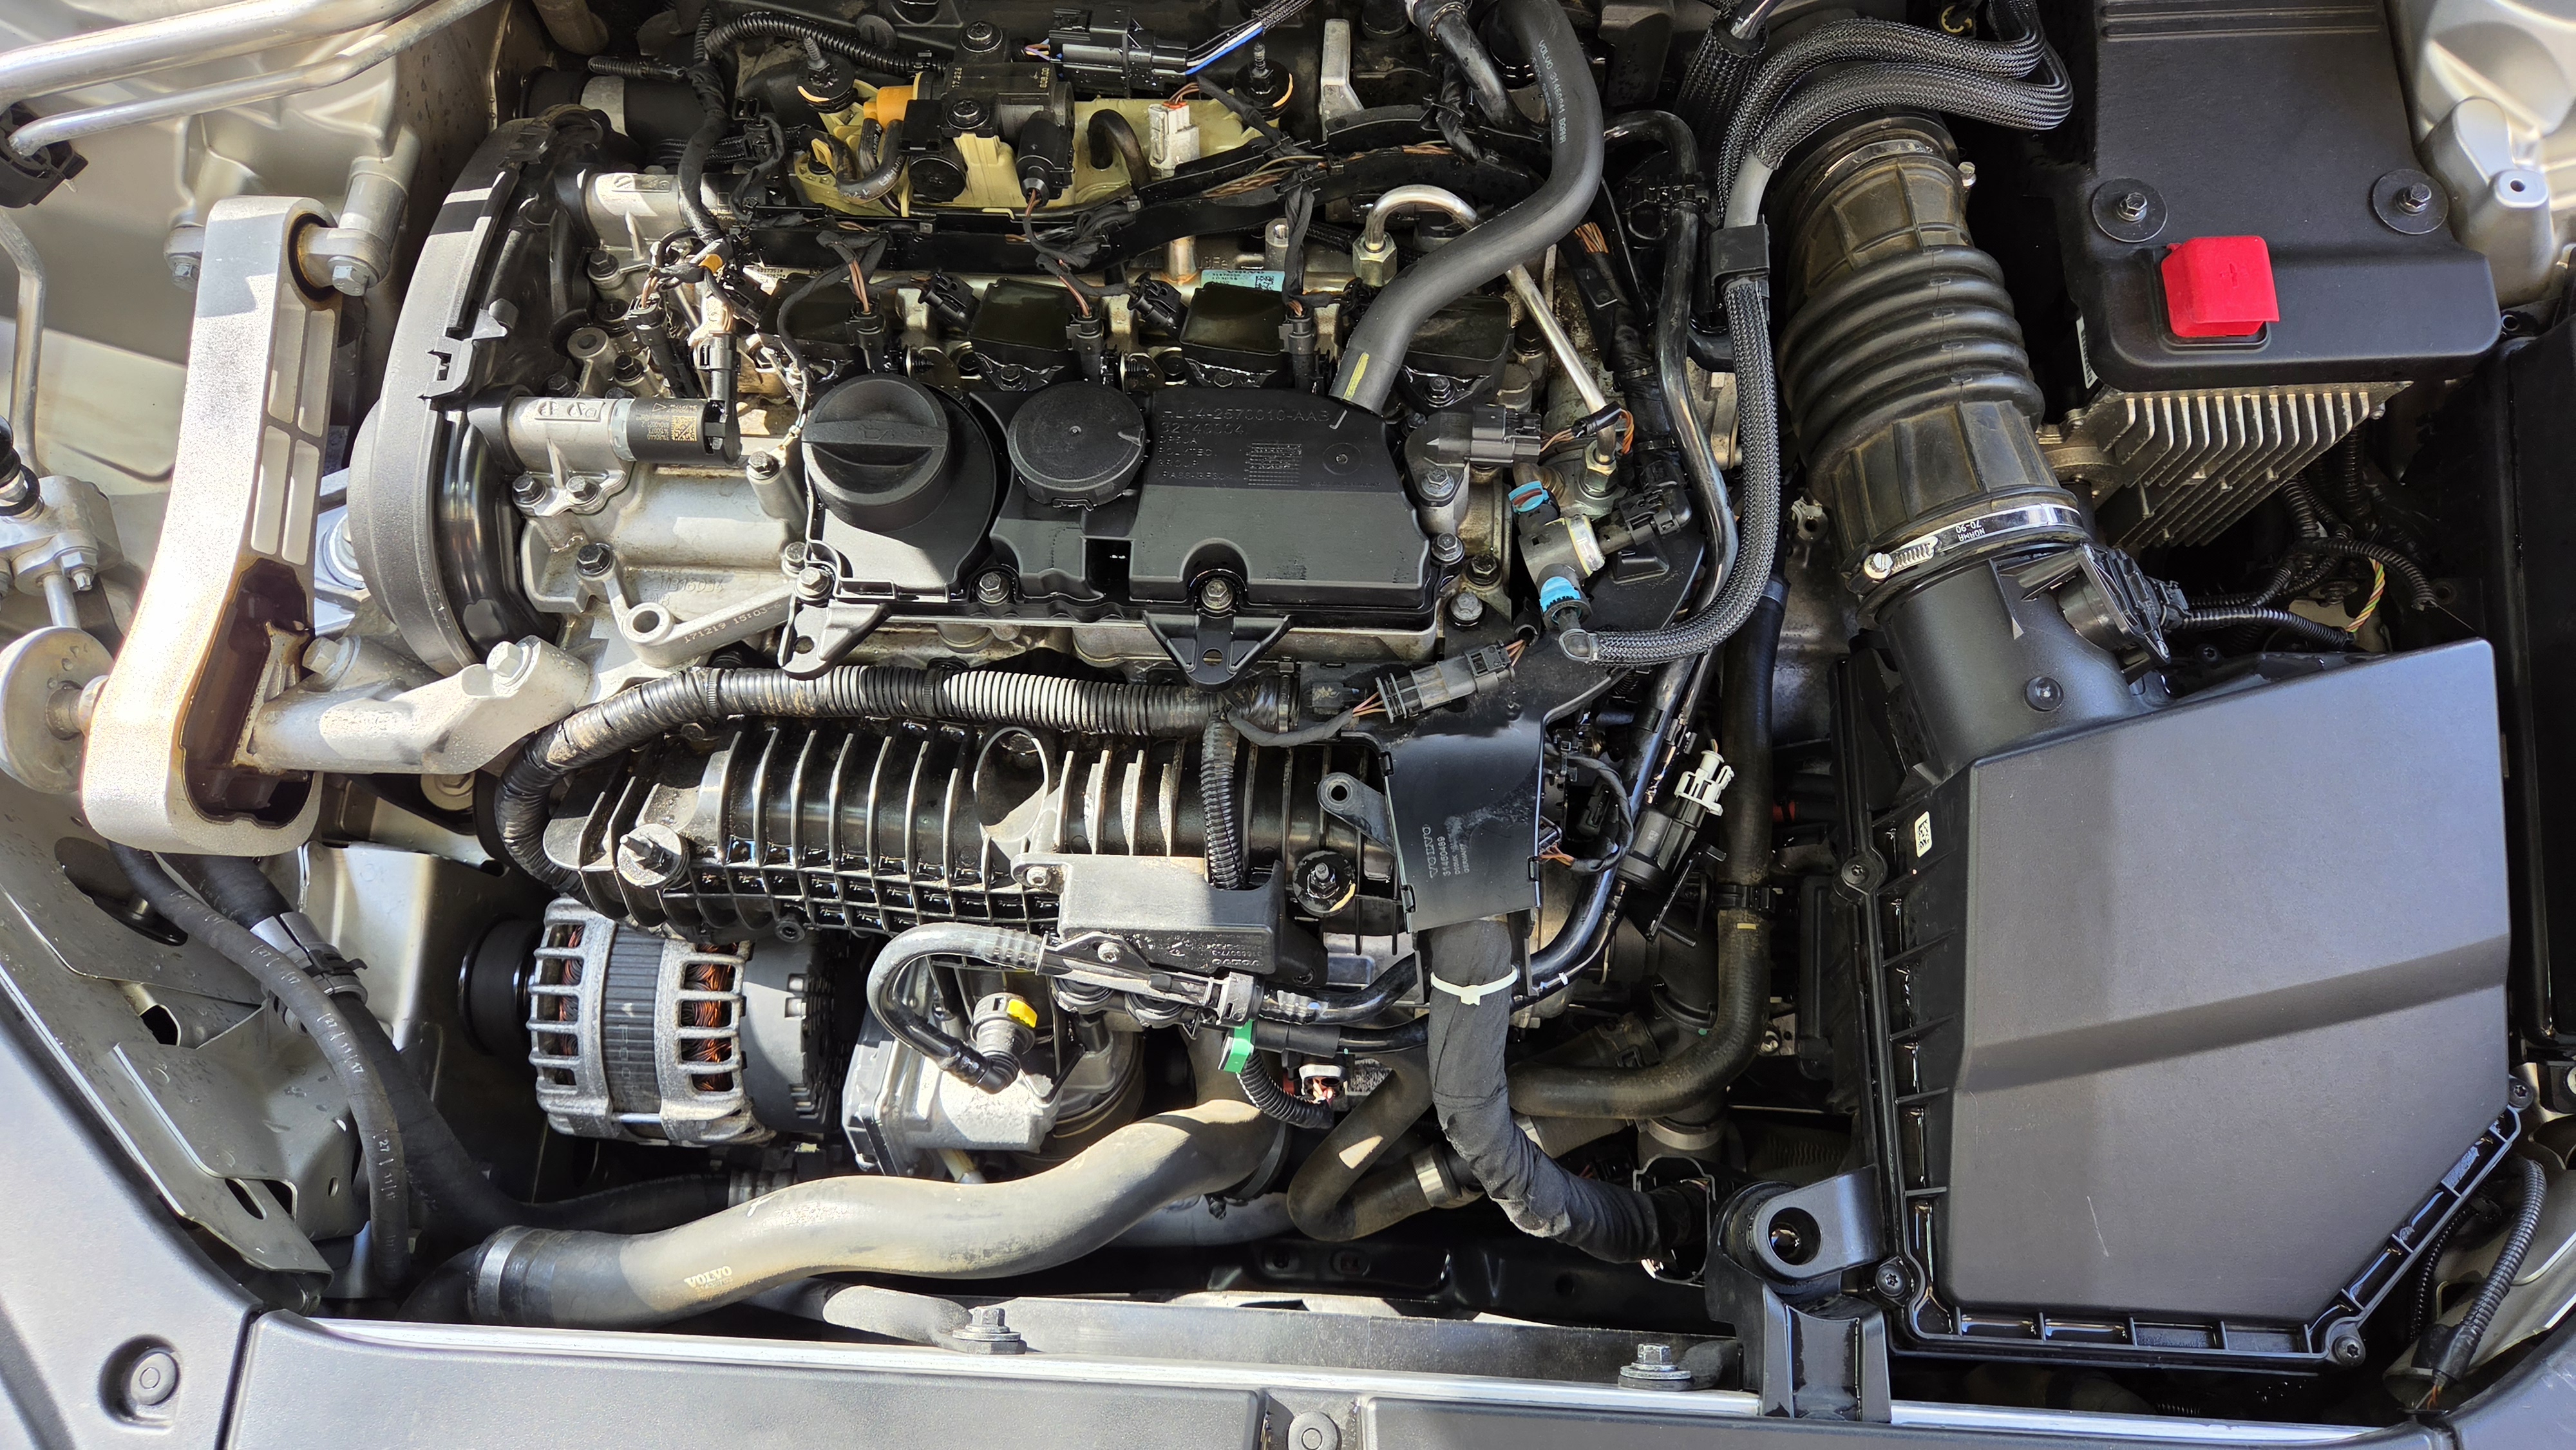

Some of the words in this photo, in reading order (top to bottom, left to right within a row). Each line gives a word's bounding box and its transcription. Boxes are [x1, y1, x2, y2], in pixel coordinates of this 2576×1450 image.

[1538, 39, 1553, 70] VOLVO
[1955, 520, 1982, 534] 70-90
[1957, 527, 1985, 541] NORMA
[684, 622, 726, 644] 171219
[1422, 824, 1439, 878] VOLVO
[1437, 836, 1451, 876] 31460489
[1211, 958, 1264, 966] VOLVO
[684, 1265, 733, 1288] VOLVO
